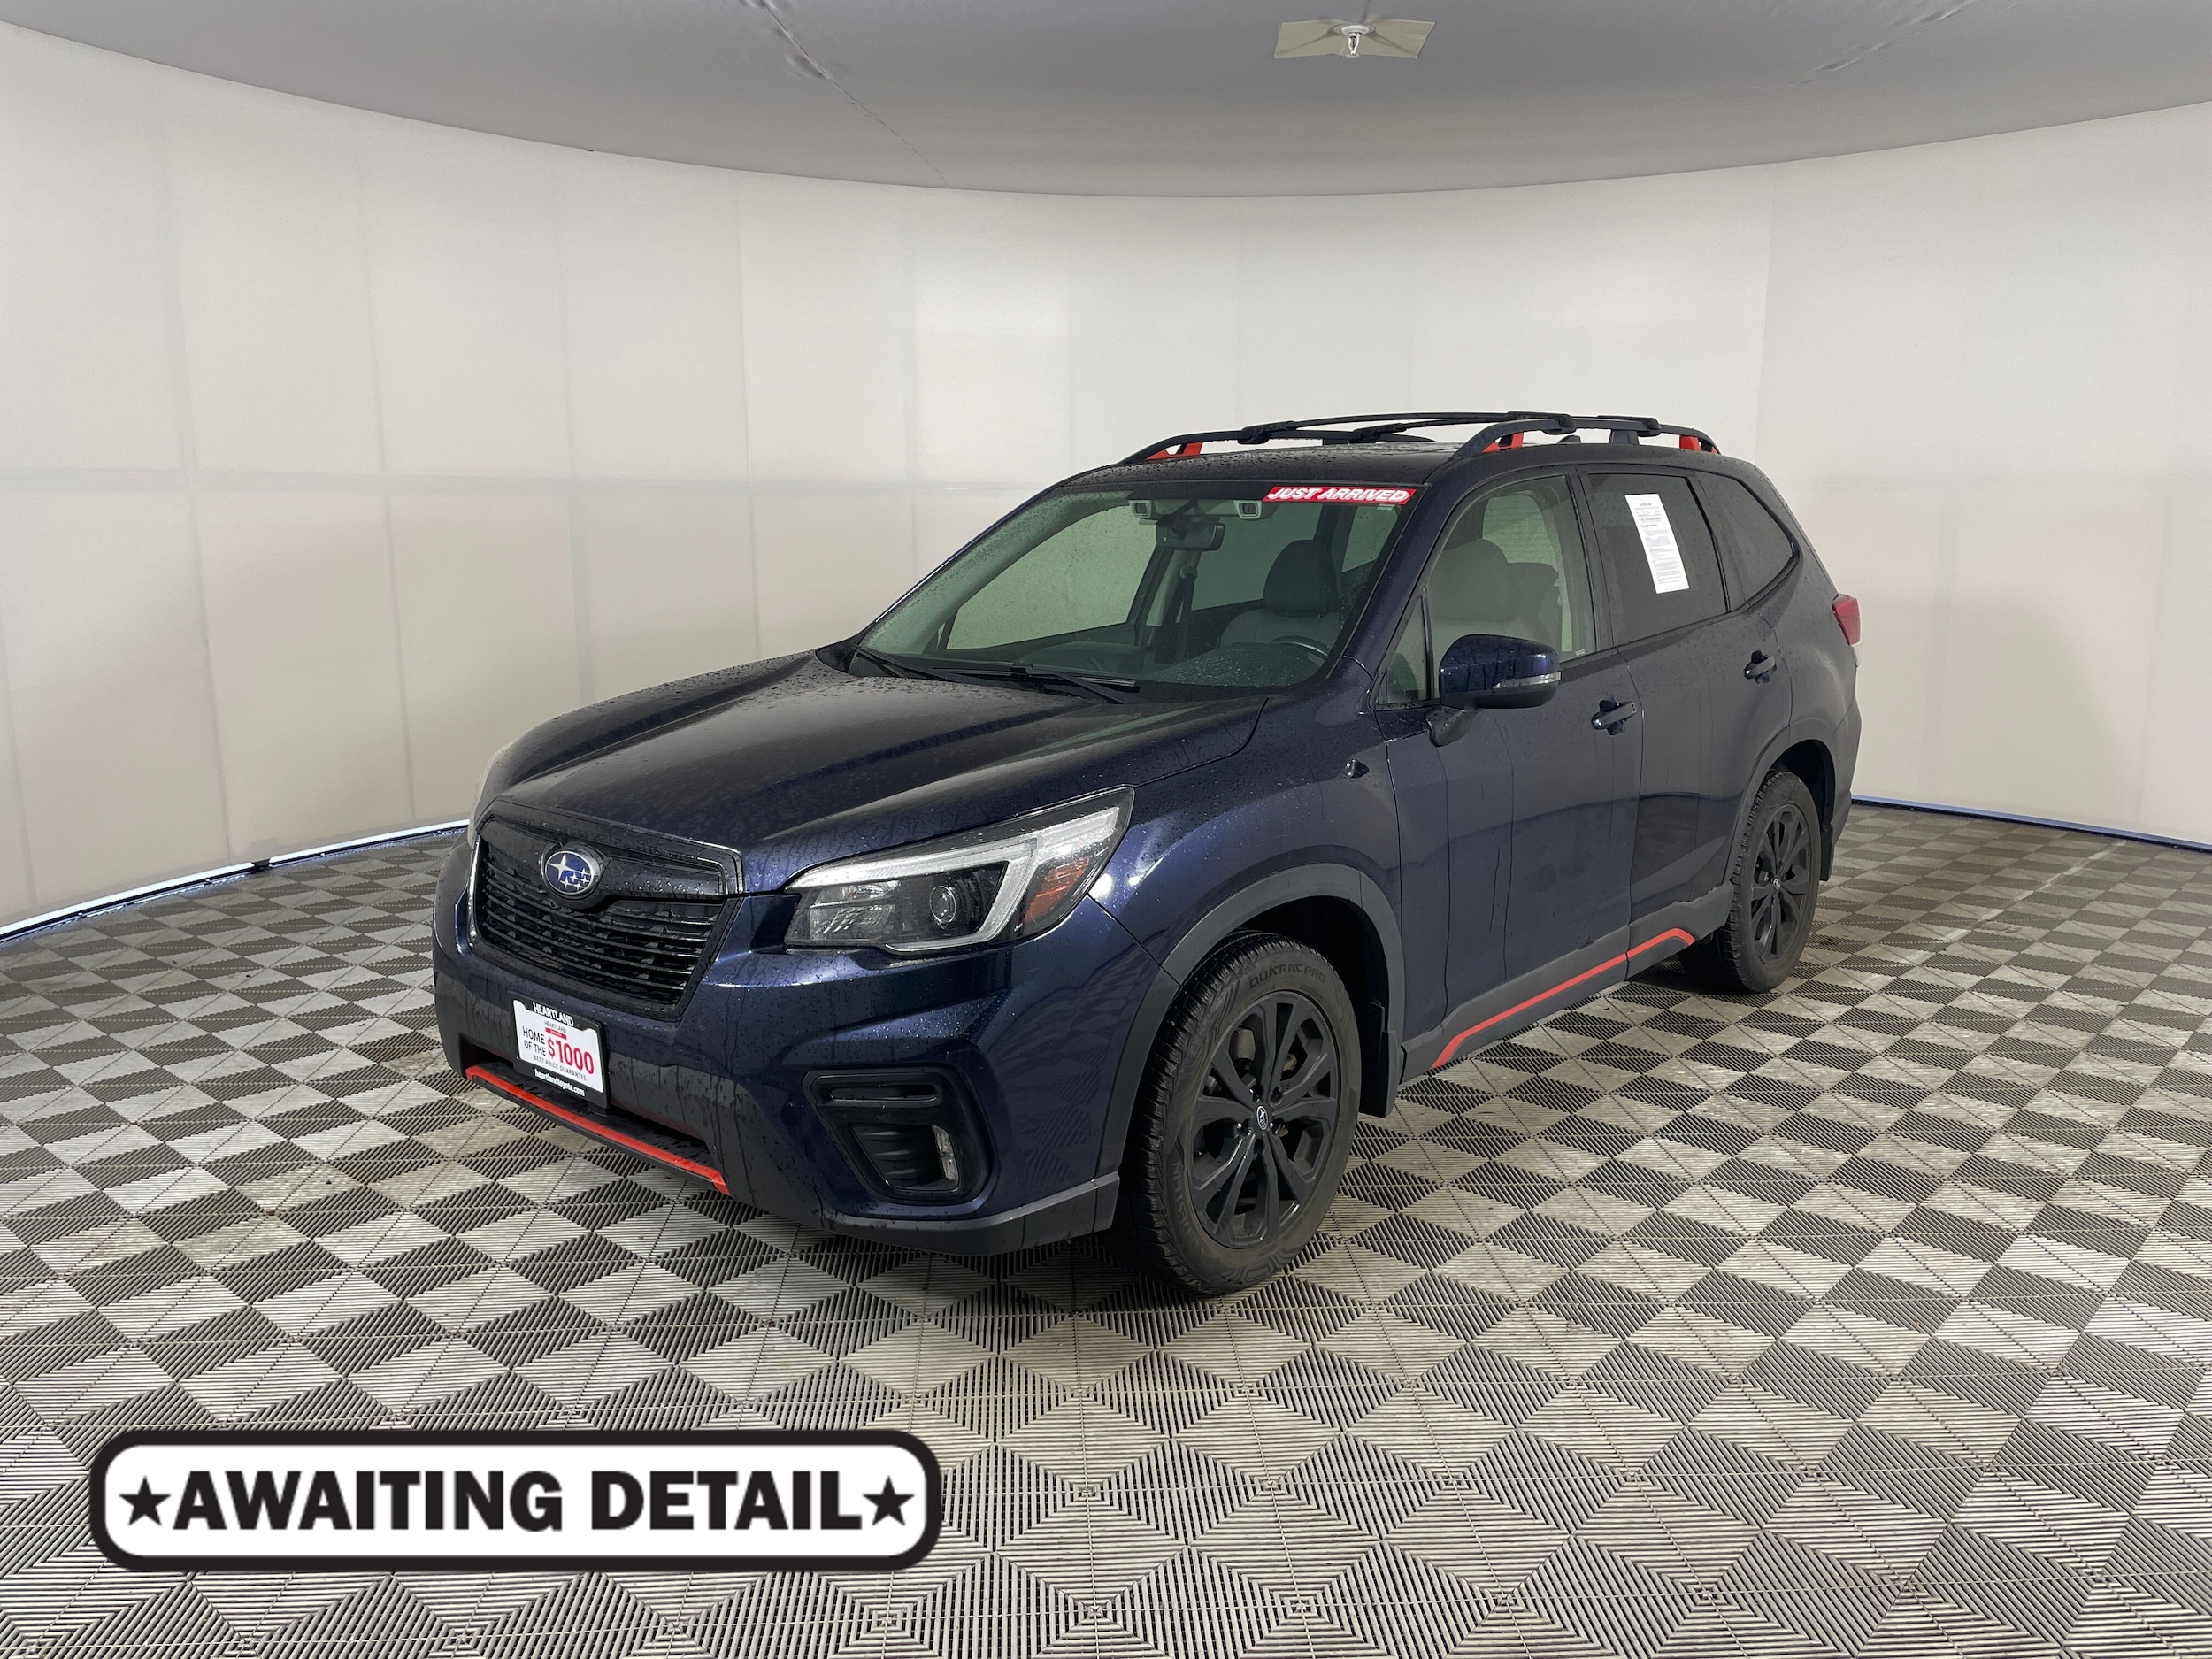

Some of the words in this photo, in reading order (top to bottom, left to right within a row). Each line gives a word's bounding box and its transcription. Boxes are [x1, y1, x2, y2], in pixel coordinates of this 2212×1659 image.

[1268, 488, 1320, 500] JUST
[1317, 488, 1409, 502] ARRIVED
[1248, 964, 1302, 988] QUATRAC
[1304, 964, 1326, 984] PRO
[533, 1002, 573, 1026] HEARTLAND
[522, 1026, 545, 1045] HOME
[524, 1040, 533, 1049] OF
[534, 1043, 547, 1057] THE
[547, 1037, 594, 1074] $1000
[534, 1055, 544, 1064] BEST
[545, 1059, 559, 1070] PRICE
[534, 1069, 585, 1096] heartlandtoyota.com
